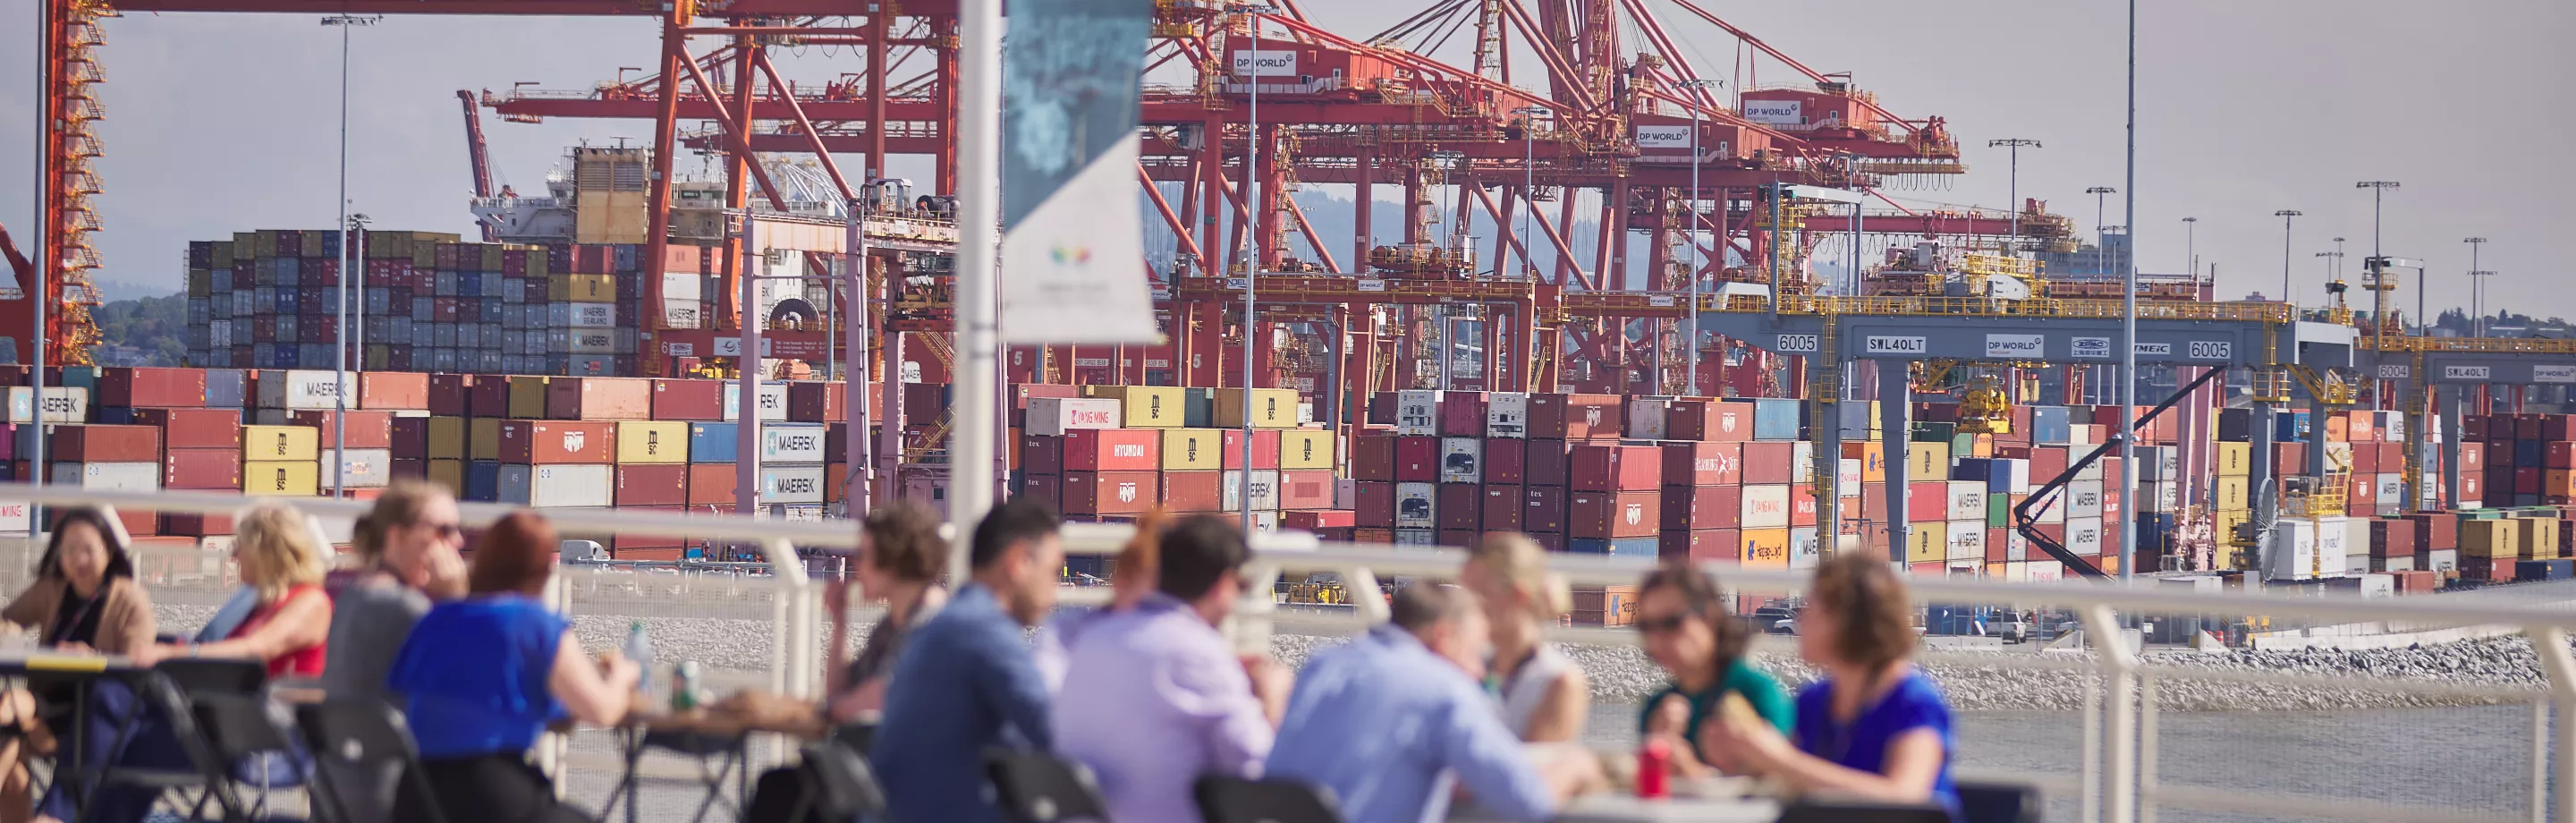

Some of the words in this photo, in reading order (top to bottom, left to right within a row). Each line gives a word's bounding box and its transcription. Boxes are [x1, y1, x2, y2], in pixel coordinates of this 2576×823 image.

[583, 308, 606, 316] MAERSK
[582, 335, 609, 346] MAERSK
[662, 342, 668, 353] 6
[1779, 335, 1815, 350] 6005
[1988, 342, 2000, 350] DP
[2002, 342, 2035, 350] WORLD
[2191, 343, 2228, 357] 6005
[1014, 351, 1022, 365] 5
[1193, 354, 1201, 368] 5
[2380, 366, 2407, 377] 6004
[1344, 379, 1352, 390] 4
[1704, 374, 1709, 384] 2
[41, 397, 77, 412] AERSK
[1093, 411, 1108, 423] MING
[779, 436, 816, 451] MAERSK
[1114, 445, 1144, 457] HYUNDAI
[777, 479, 815, 493] MAERSK
[1250, 482, 1270, 498] ERSK
[1530, 489, 1542, 497] tex
[1958, 493, 1981, 507] MAERSK
[2077, 492, 2097, 506] MAERSK
[3, 505, 21, 517] MING
[1957, 532, 1980, 547] MAERSK
[2075, 529, 2097, 543] MAERSK
